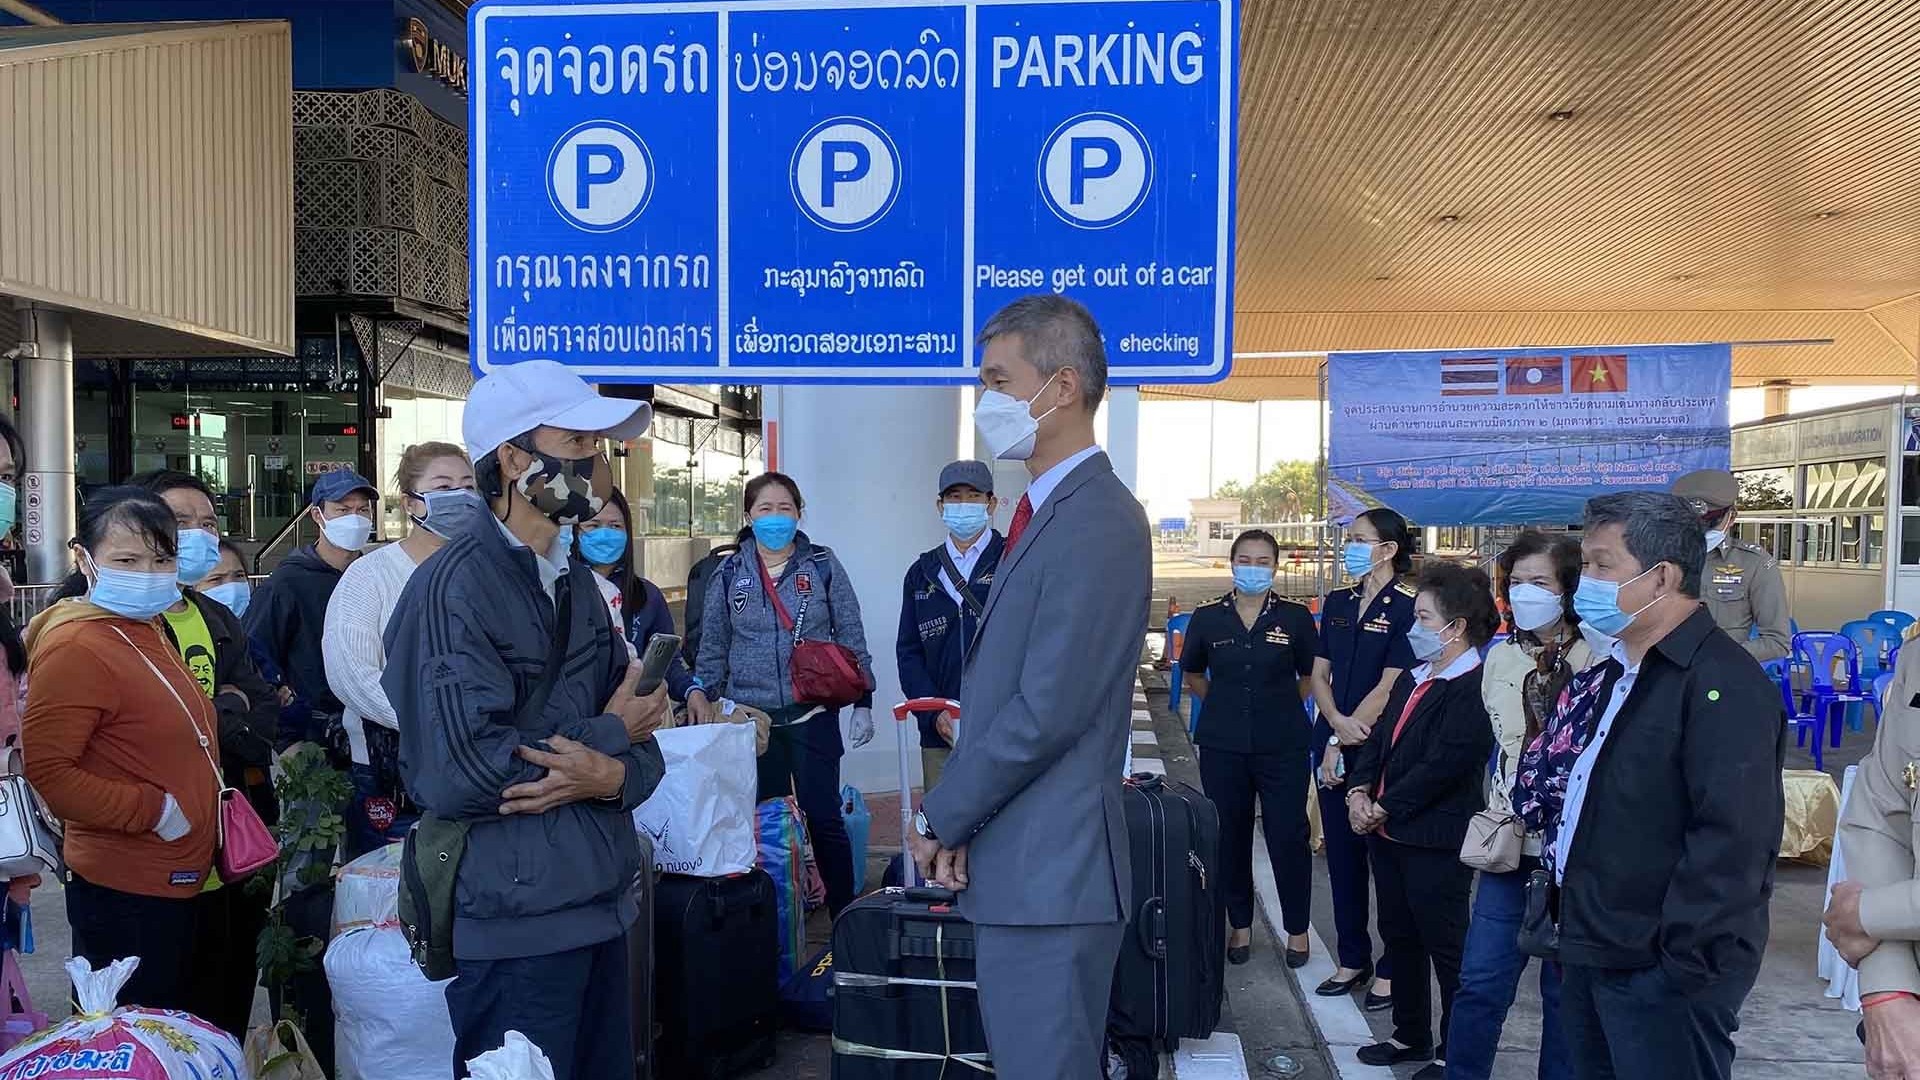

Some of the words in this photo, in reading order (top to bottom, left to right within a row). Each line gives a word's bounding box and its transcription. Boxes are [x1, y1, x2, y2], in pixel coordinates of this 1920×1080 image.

[496, 42, 709, 116] จุดจอดรถ
[735, 29, 960, 92] ບ່ອນຈອດລົດ
[992, 31, 1204, 88] PARKING
[576, 144, 625, 210] P
[820, 140, 870, 207] P
[1070, 137, 1122, 205] P
[496, 254, 709, 302] กรุณาลงจากรถ
[977, 265, 1043, 289] Please
[1052, 265, 1086, 293] get
[1094, 265, 1128, 287] out
[1136, 264, 1157, 287] of
[1162, 269, 1174, 286] a
[1178, 266, 1213, 287] car
[494, 308, 712, 353] เพื่อตรวจสอบเอกสาร
[1120, 332, 1199, 357] checking
[666, 857, 703, 873] nuovo
